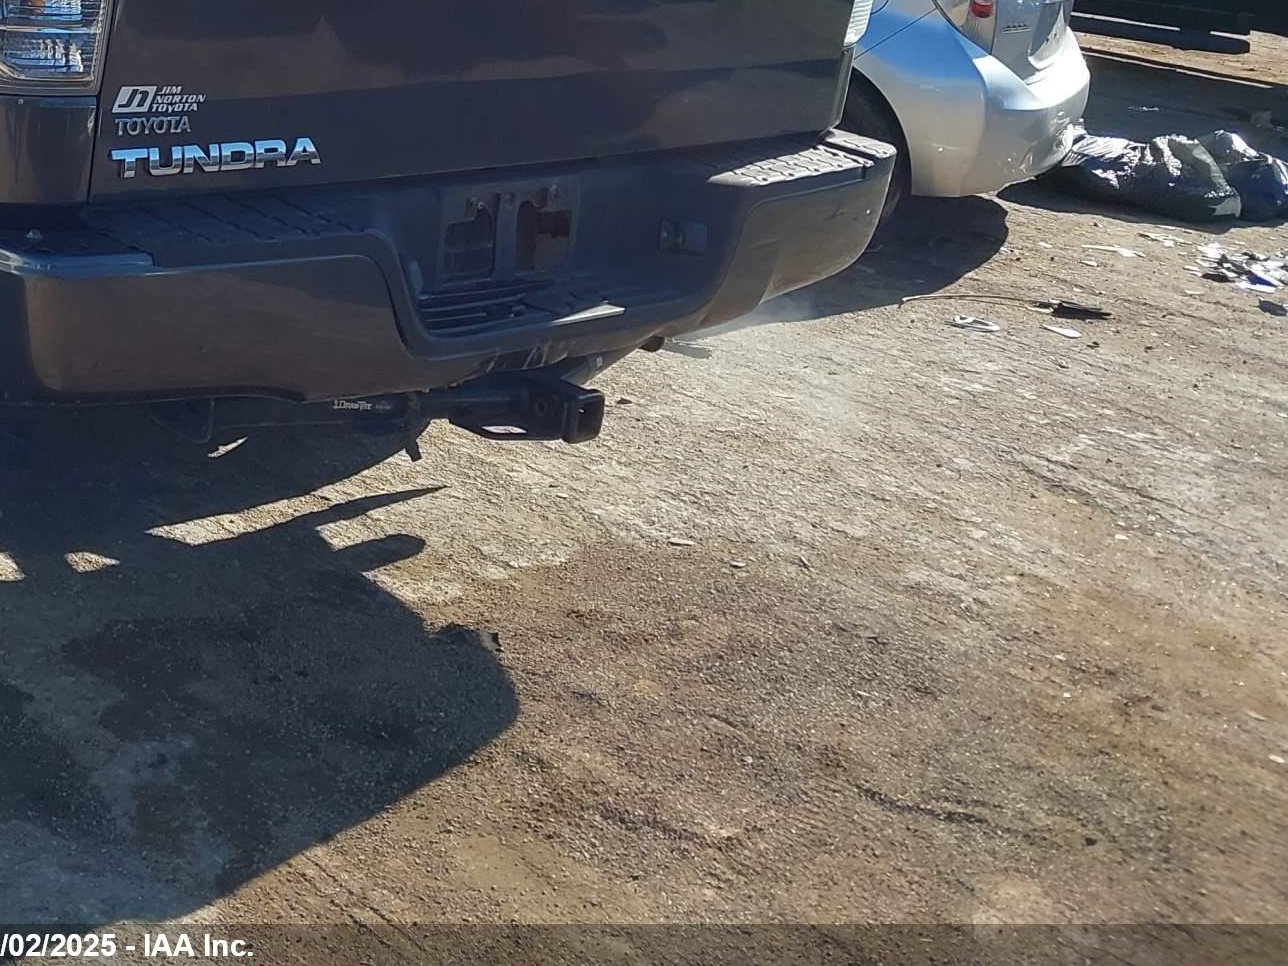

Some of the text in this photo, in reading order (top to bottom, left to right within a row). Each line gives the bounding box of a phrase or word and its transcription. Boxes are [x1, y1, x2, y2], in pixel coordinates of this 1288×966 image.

[157, 85, 183, 95] JIM
[154, 94, 206, 104] NORTON
[151, 102, 199, 114] TOYOTA
[114, 115, 192, 136] TOYOTA
[110, 137, 321, 179] TUNDRA
